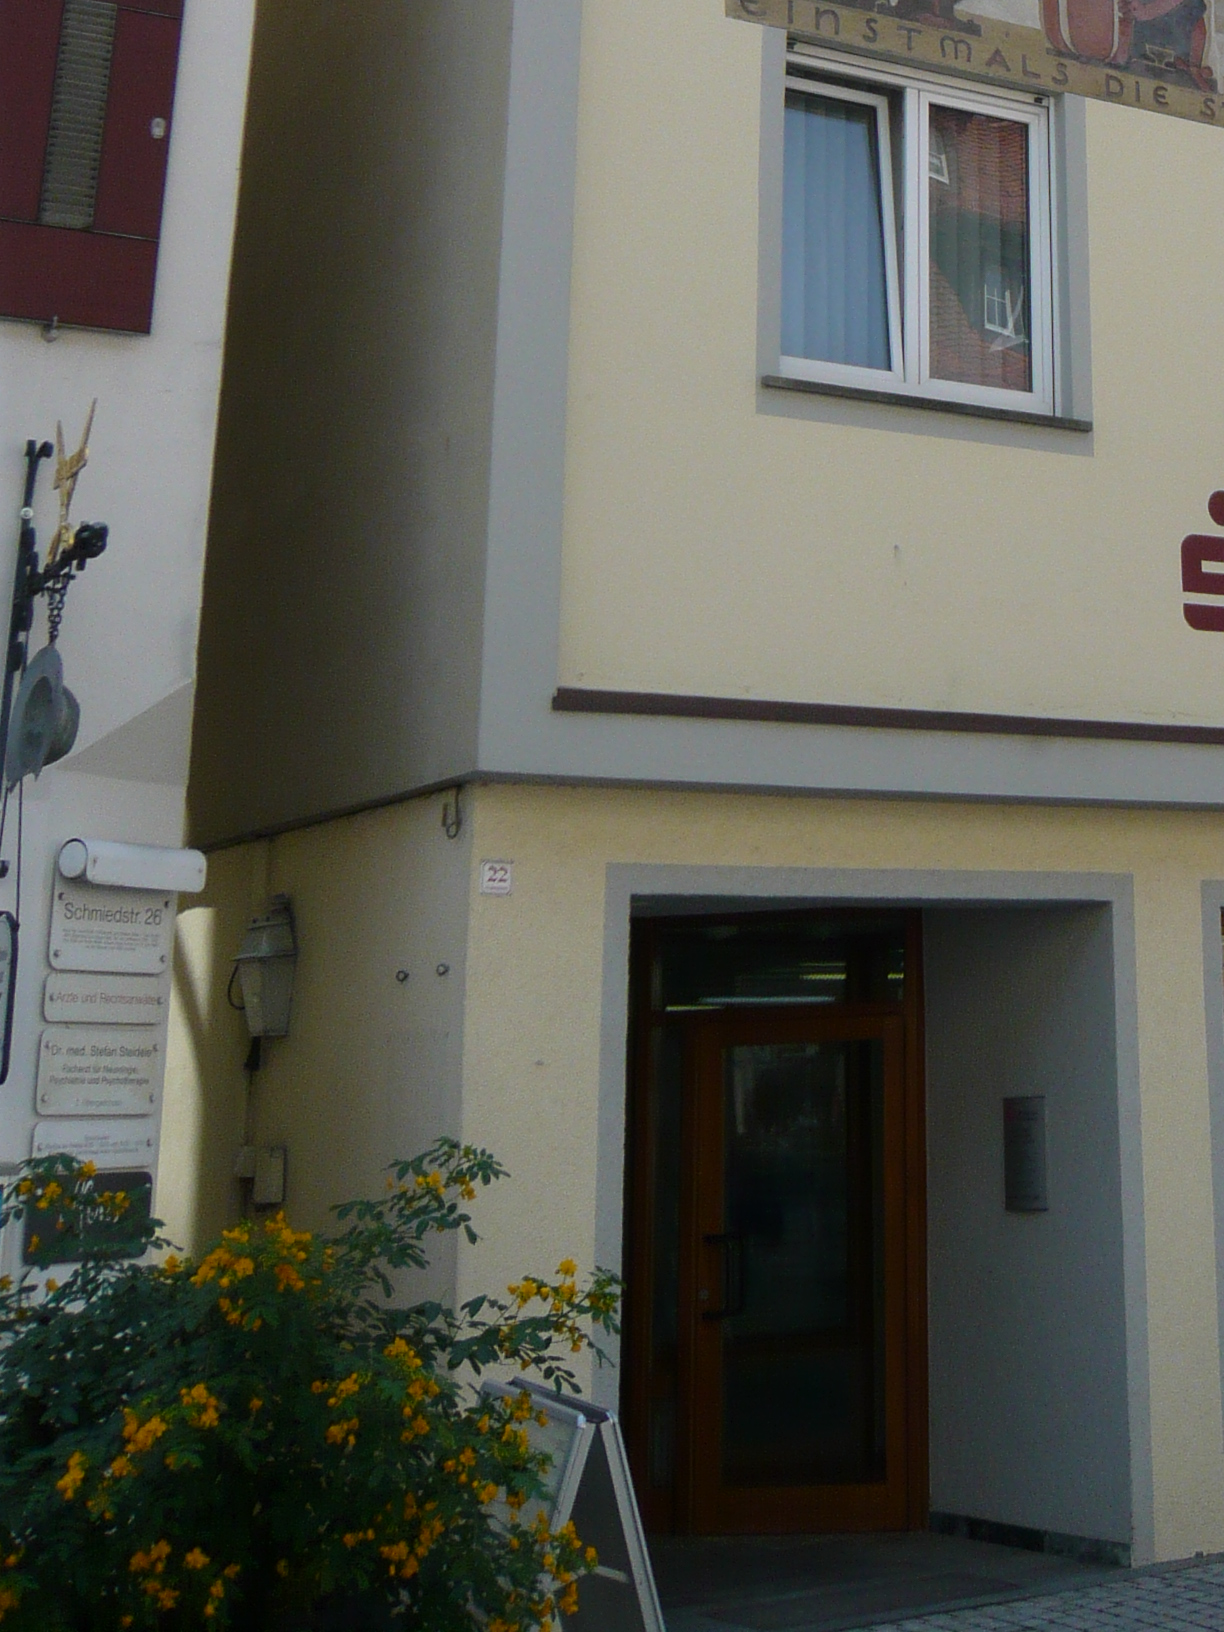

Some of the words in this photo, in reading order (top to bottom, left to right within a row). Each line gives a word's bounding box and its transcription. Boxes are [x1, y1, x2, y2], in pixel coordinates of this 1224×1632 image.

[1105, 73, 1169, 107] DIE
[487, 865, 508, 883] 22
[64, 902, 142, 925] Schmiedstr.
[144, 909, 163, 926] 26
